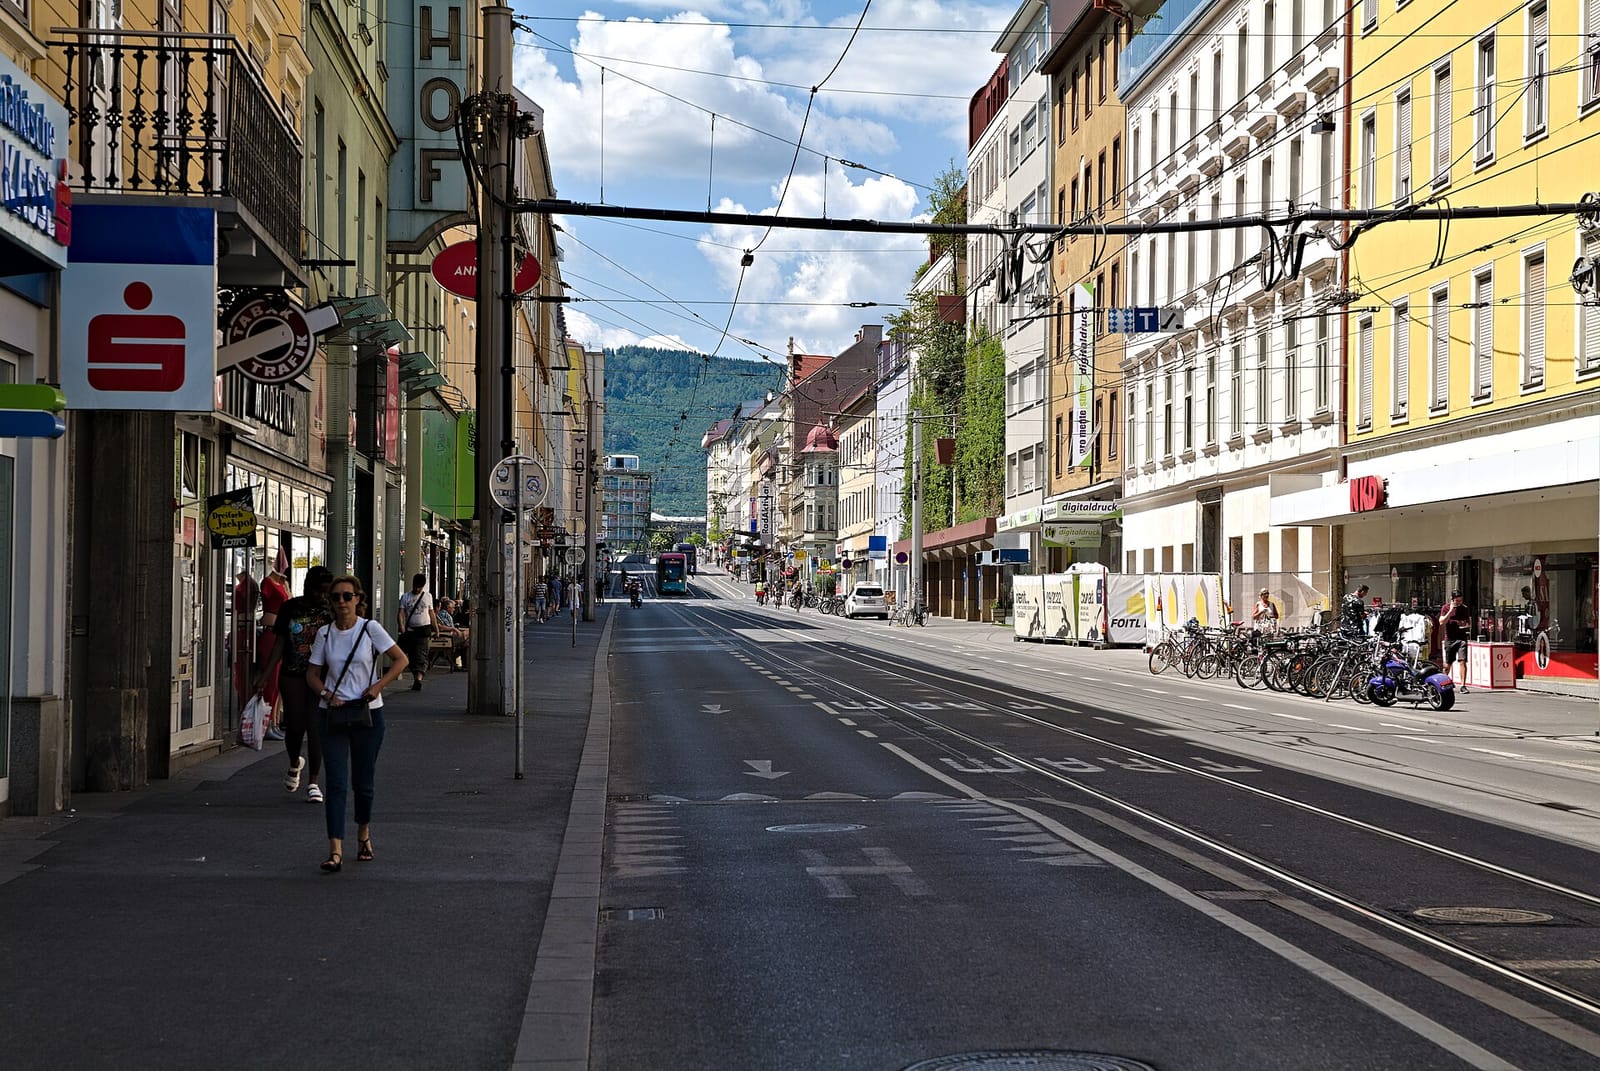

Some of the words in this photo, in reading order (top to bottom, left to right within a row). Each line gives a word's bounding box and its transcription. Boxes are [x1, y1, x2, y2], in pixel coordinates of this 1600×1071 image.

[250, 333, 308, 377] TRAFIK
[574, 447, 585, 513] HOTEL
[1349, 475, 1379, 512] NKD
[1061, 502, 1118, 513] digitaldruck
[216, 517, 255, 531] Jackpot
[1058, 528, 1101, 537] digitaldruck
[222, 537, 248, 547] LOTTO
[1110, 618, 1142, 629] FOITL
